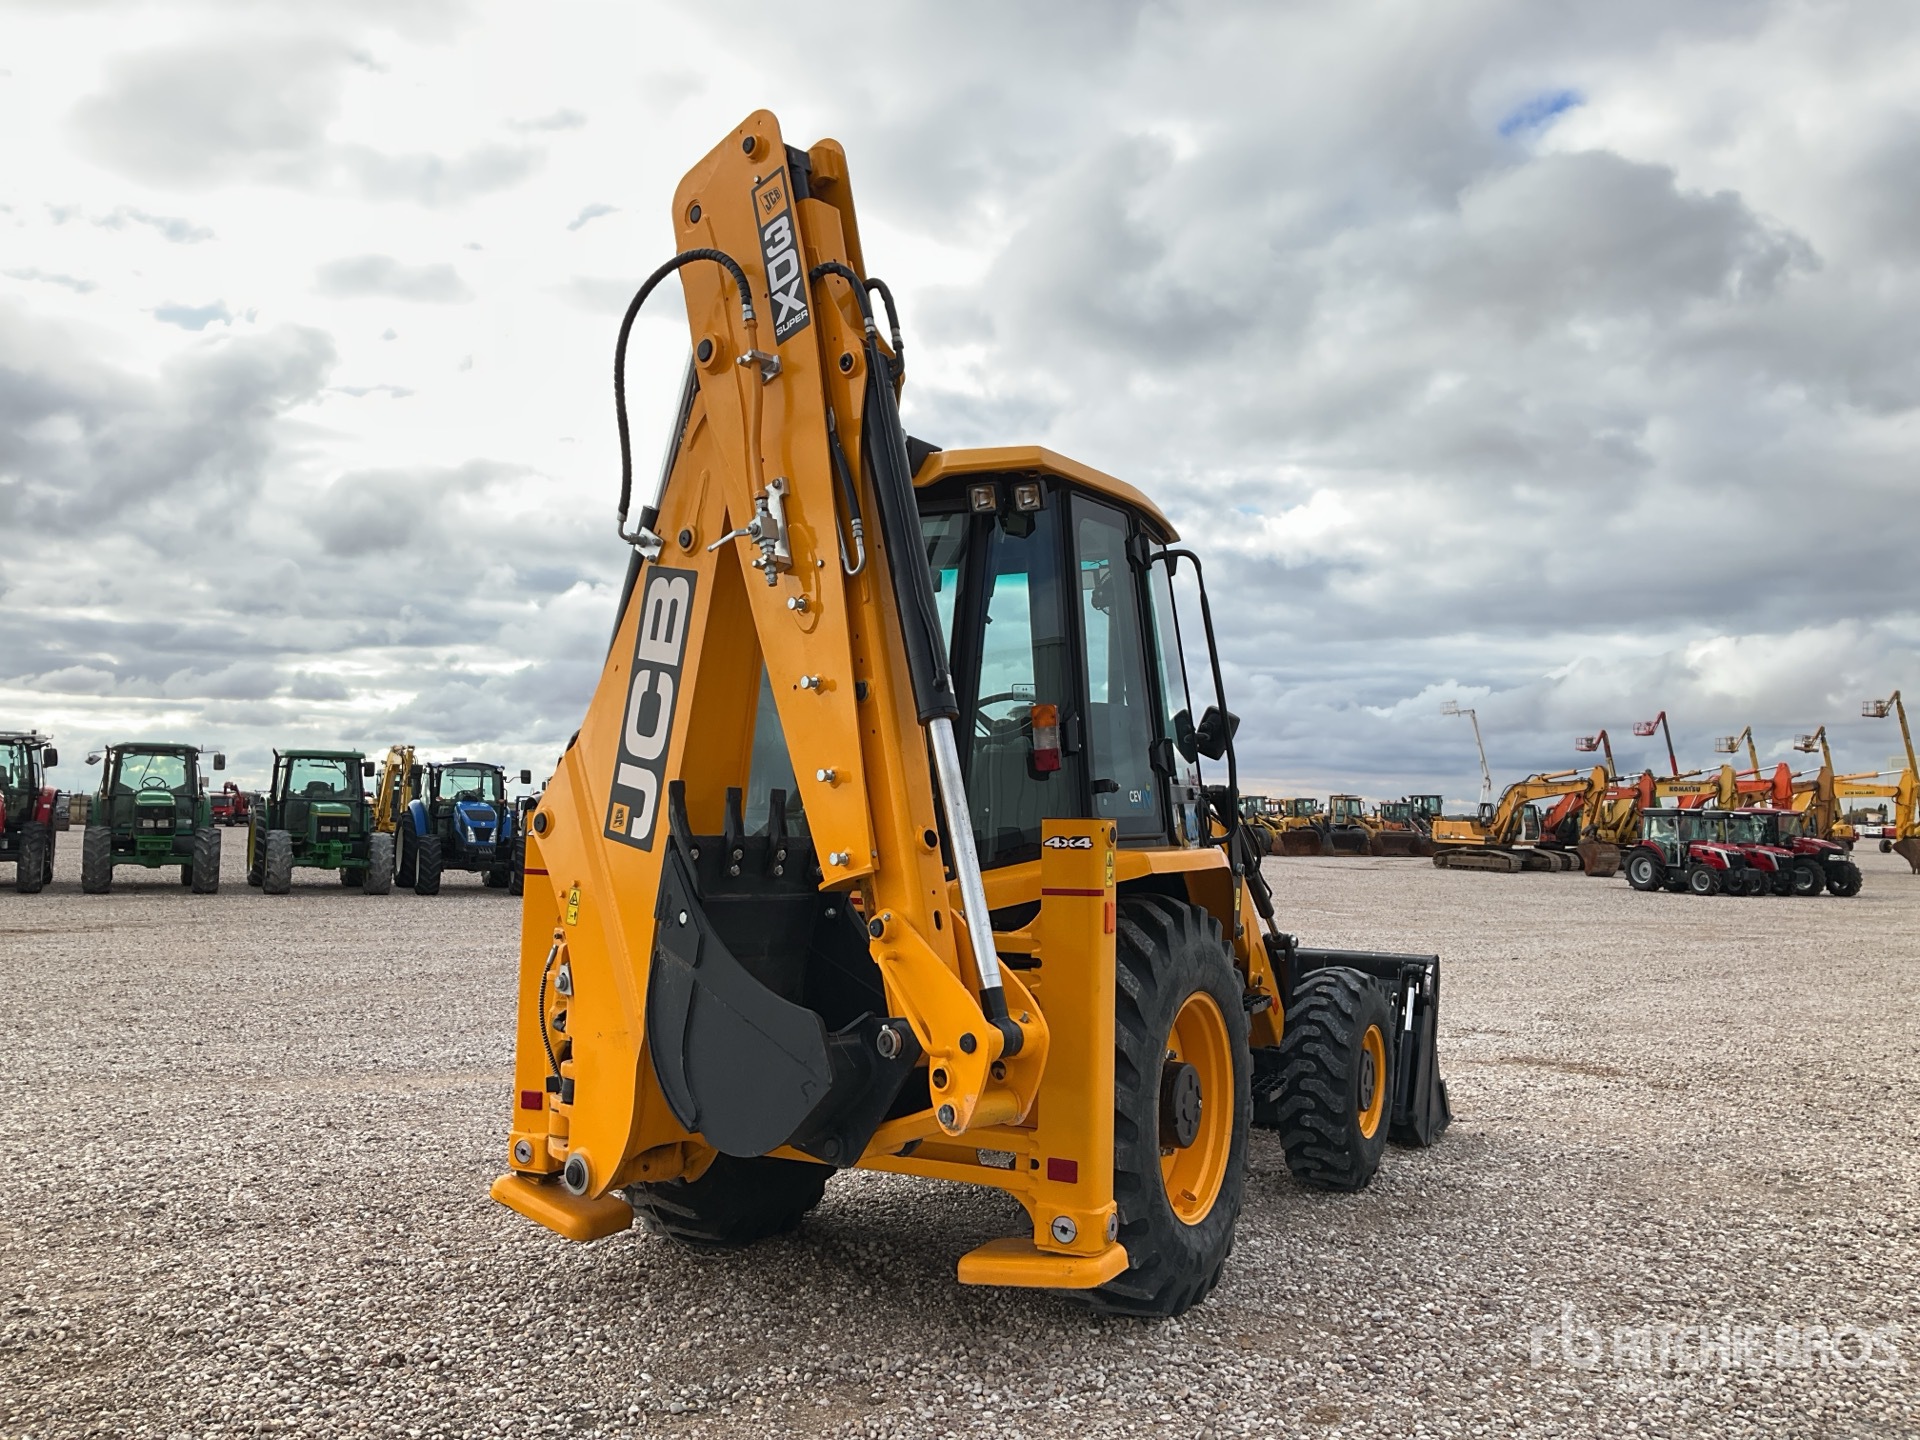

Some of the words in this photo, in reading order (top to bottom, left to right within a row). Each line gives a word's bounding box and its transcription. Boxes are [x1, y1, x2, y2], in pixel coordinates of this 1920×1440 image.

[764, 188, 781, 211] JCB
[764, 215, 807, 326] 3DX
[776, 309, 809, 336] SUPER
[617, 576, 690, 840] JCB
[1129, 790, 1142, 803] CEV
